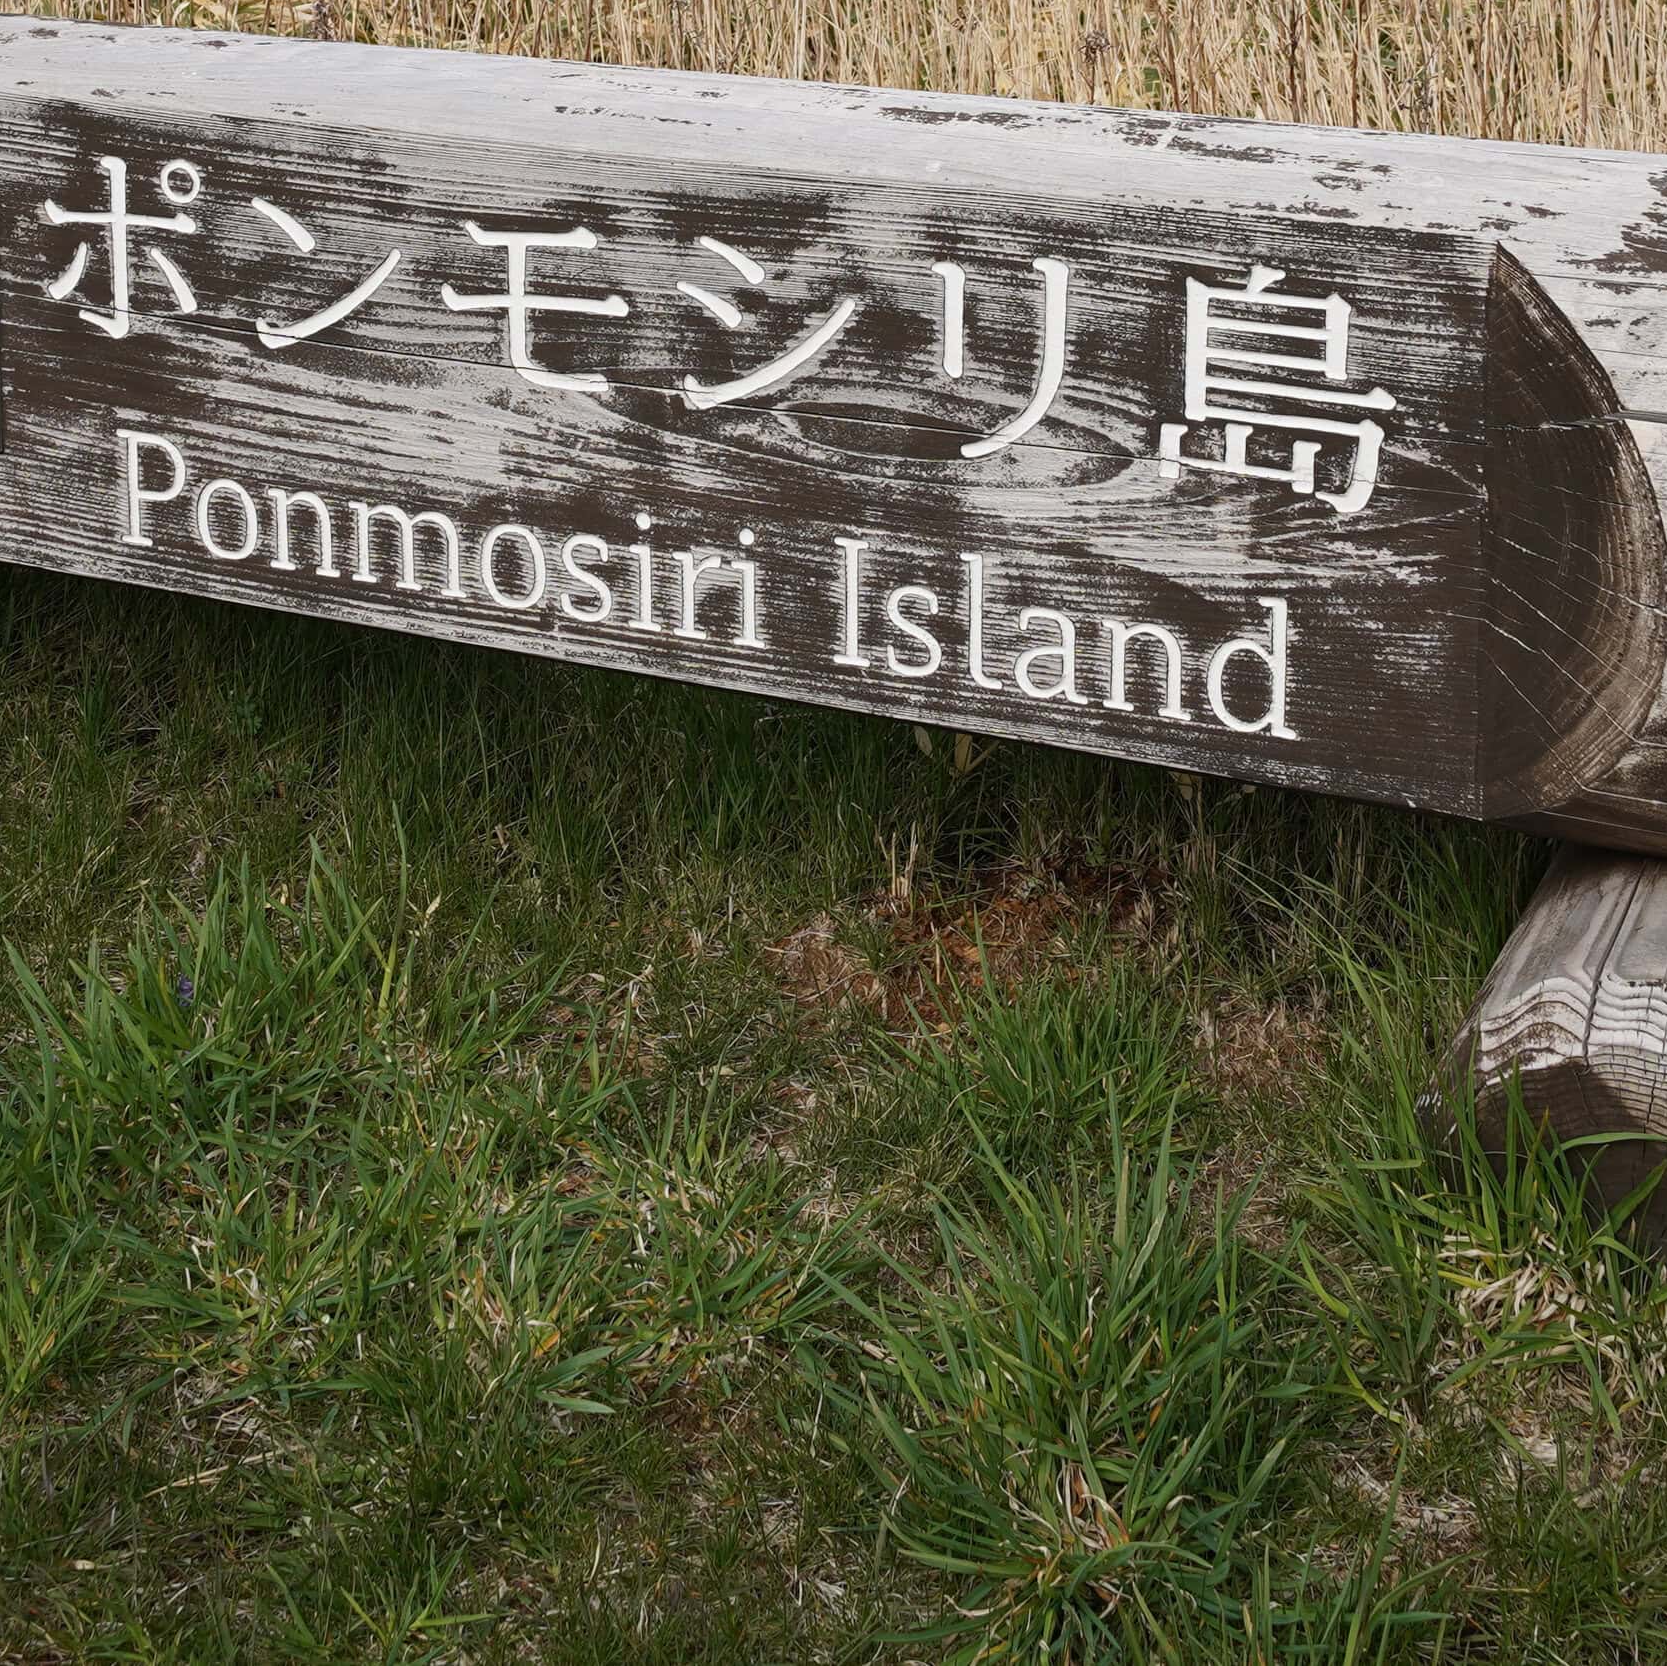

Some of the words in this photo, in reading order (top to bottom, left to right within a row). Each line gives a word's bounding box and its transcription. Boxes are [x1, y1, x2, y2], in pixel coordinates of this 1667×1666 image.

[42, 155, 1398, 517] ポンモシリ島
[115, 428, 768, 649] Ponmosiri
[831, 535, 1296, 739] Island
